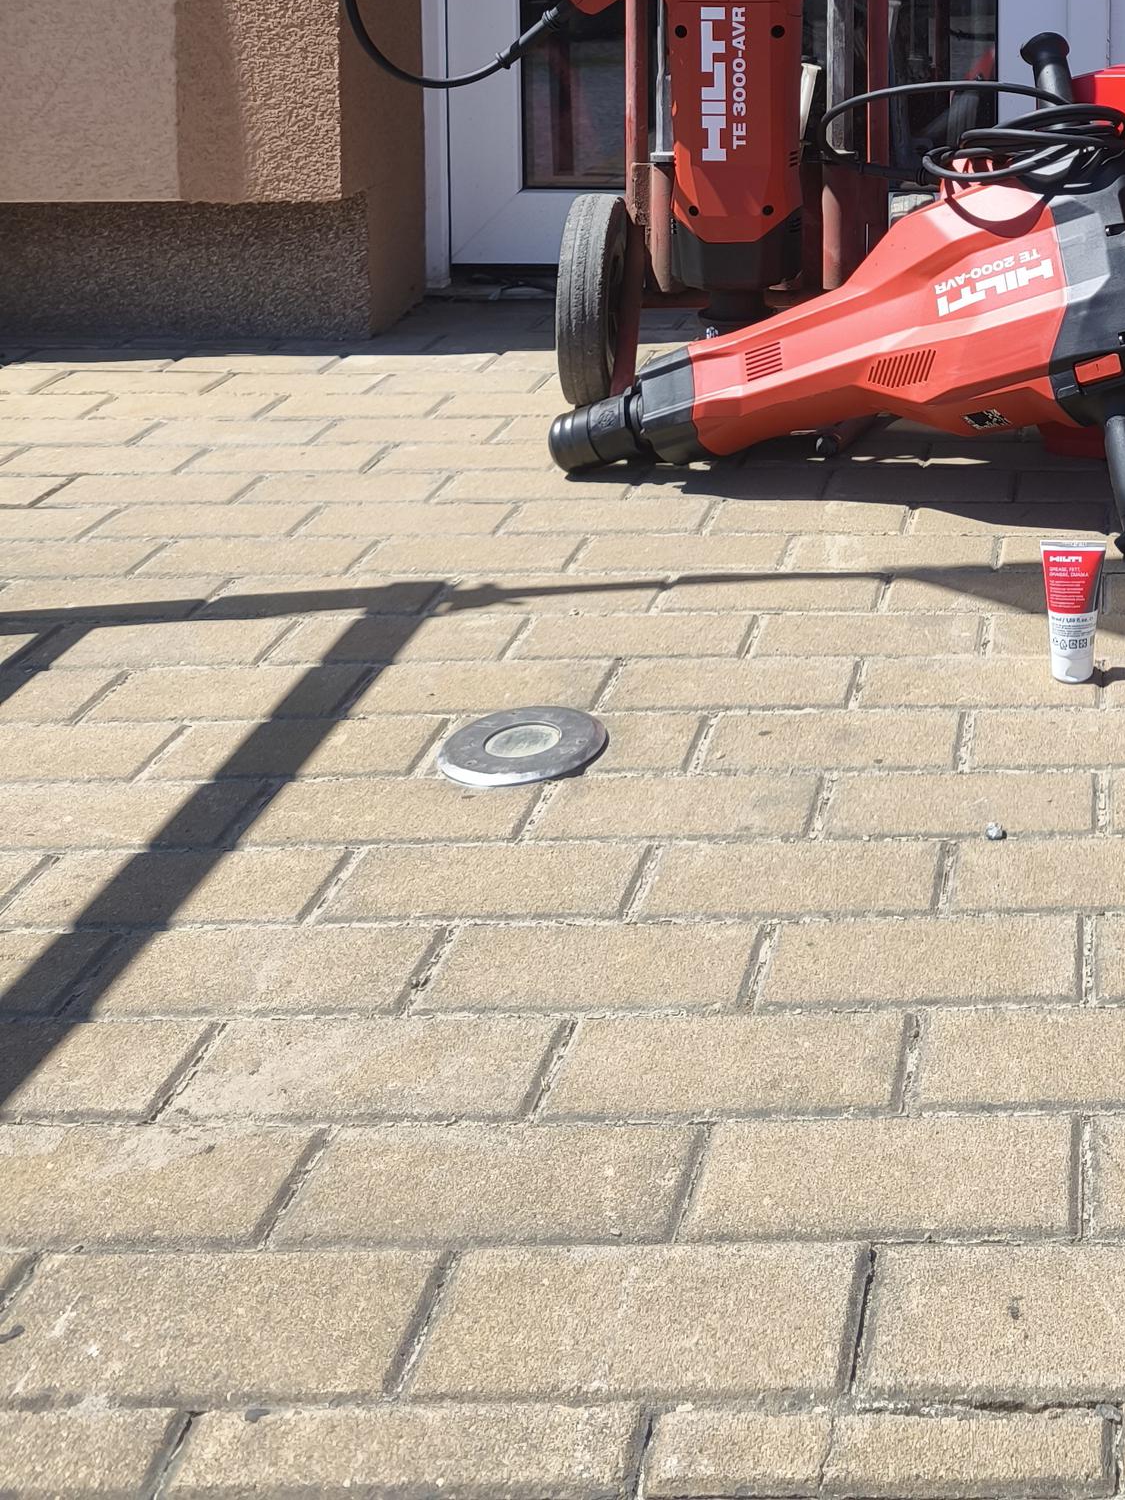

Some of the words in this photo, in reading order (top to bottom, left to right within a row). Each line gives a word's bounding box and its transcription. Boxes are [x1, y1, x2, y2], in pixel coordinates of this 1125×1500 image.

[732, 6, 747, 117] 3000-AVR
[700, 6, 727, 161] HILTI
[733, 122, 747, 150] TE
[934, 256, 1015, 295] 2000-AVR
[1019, 248, 1041, 264] TE
[936, 258, 1054, 317] HILTI
[1049, 555, 1083, 563] HILTI
